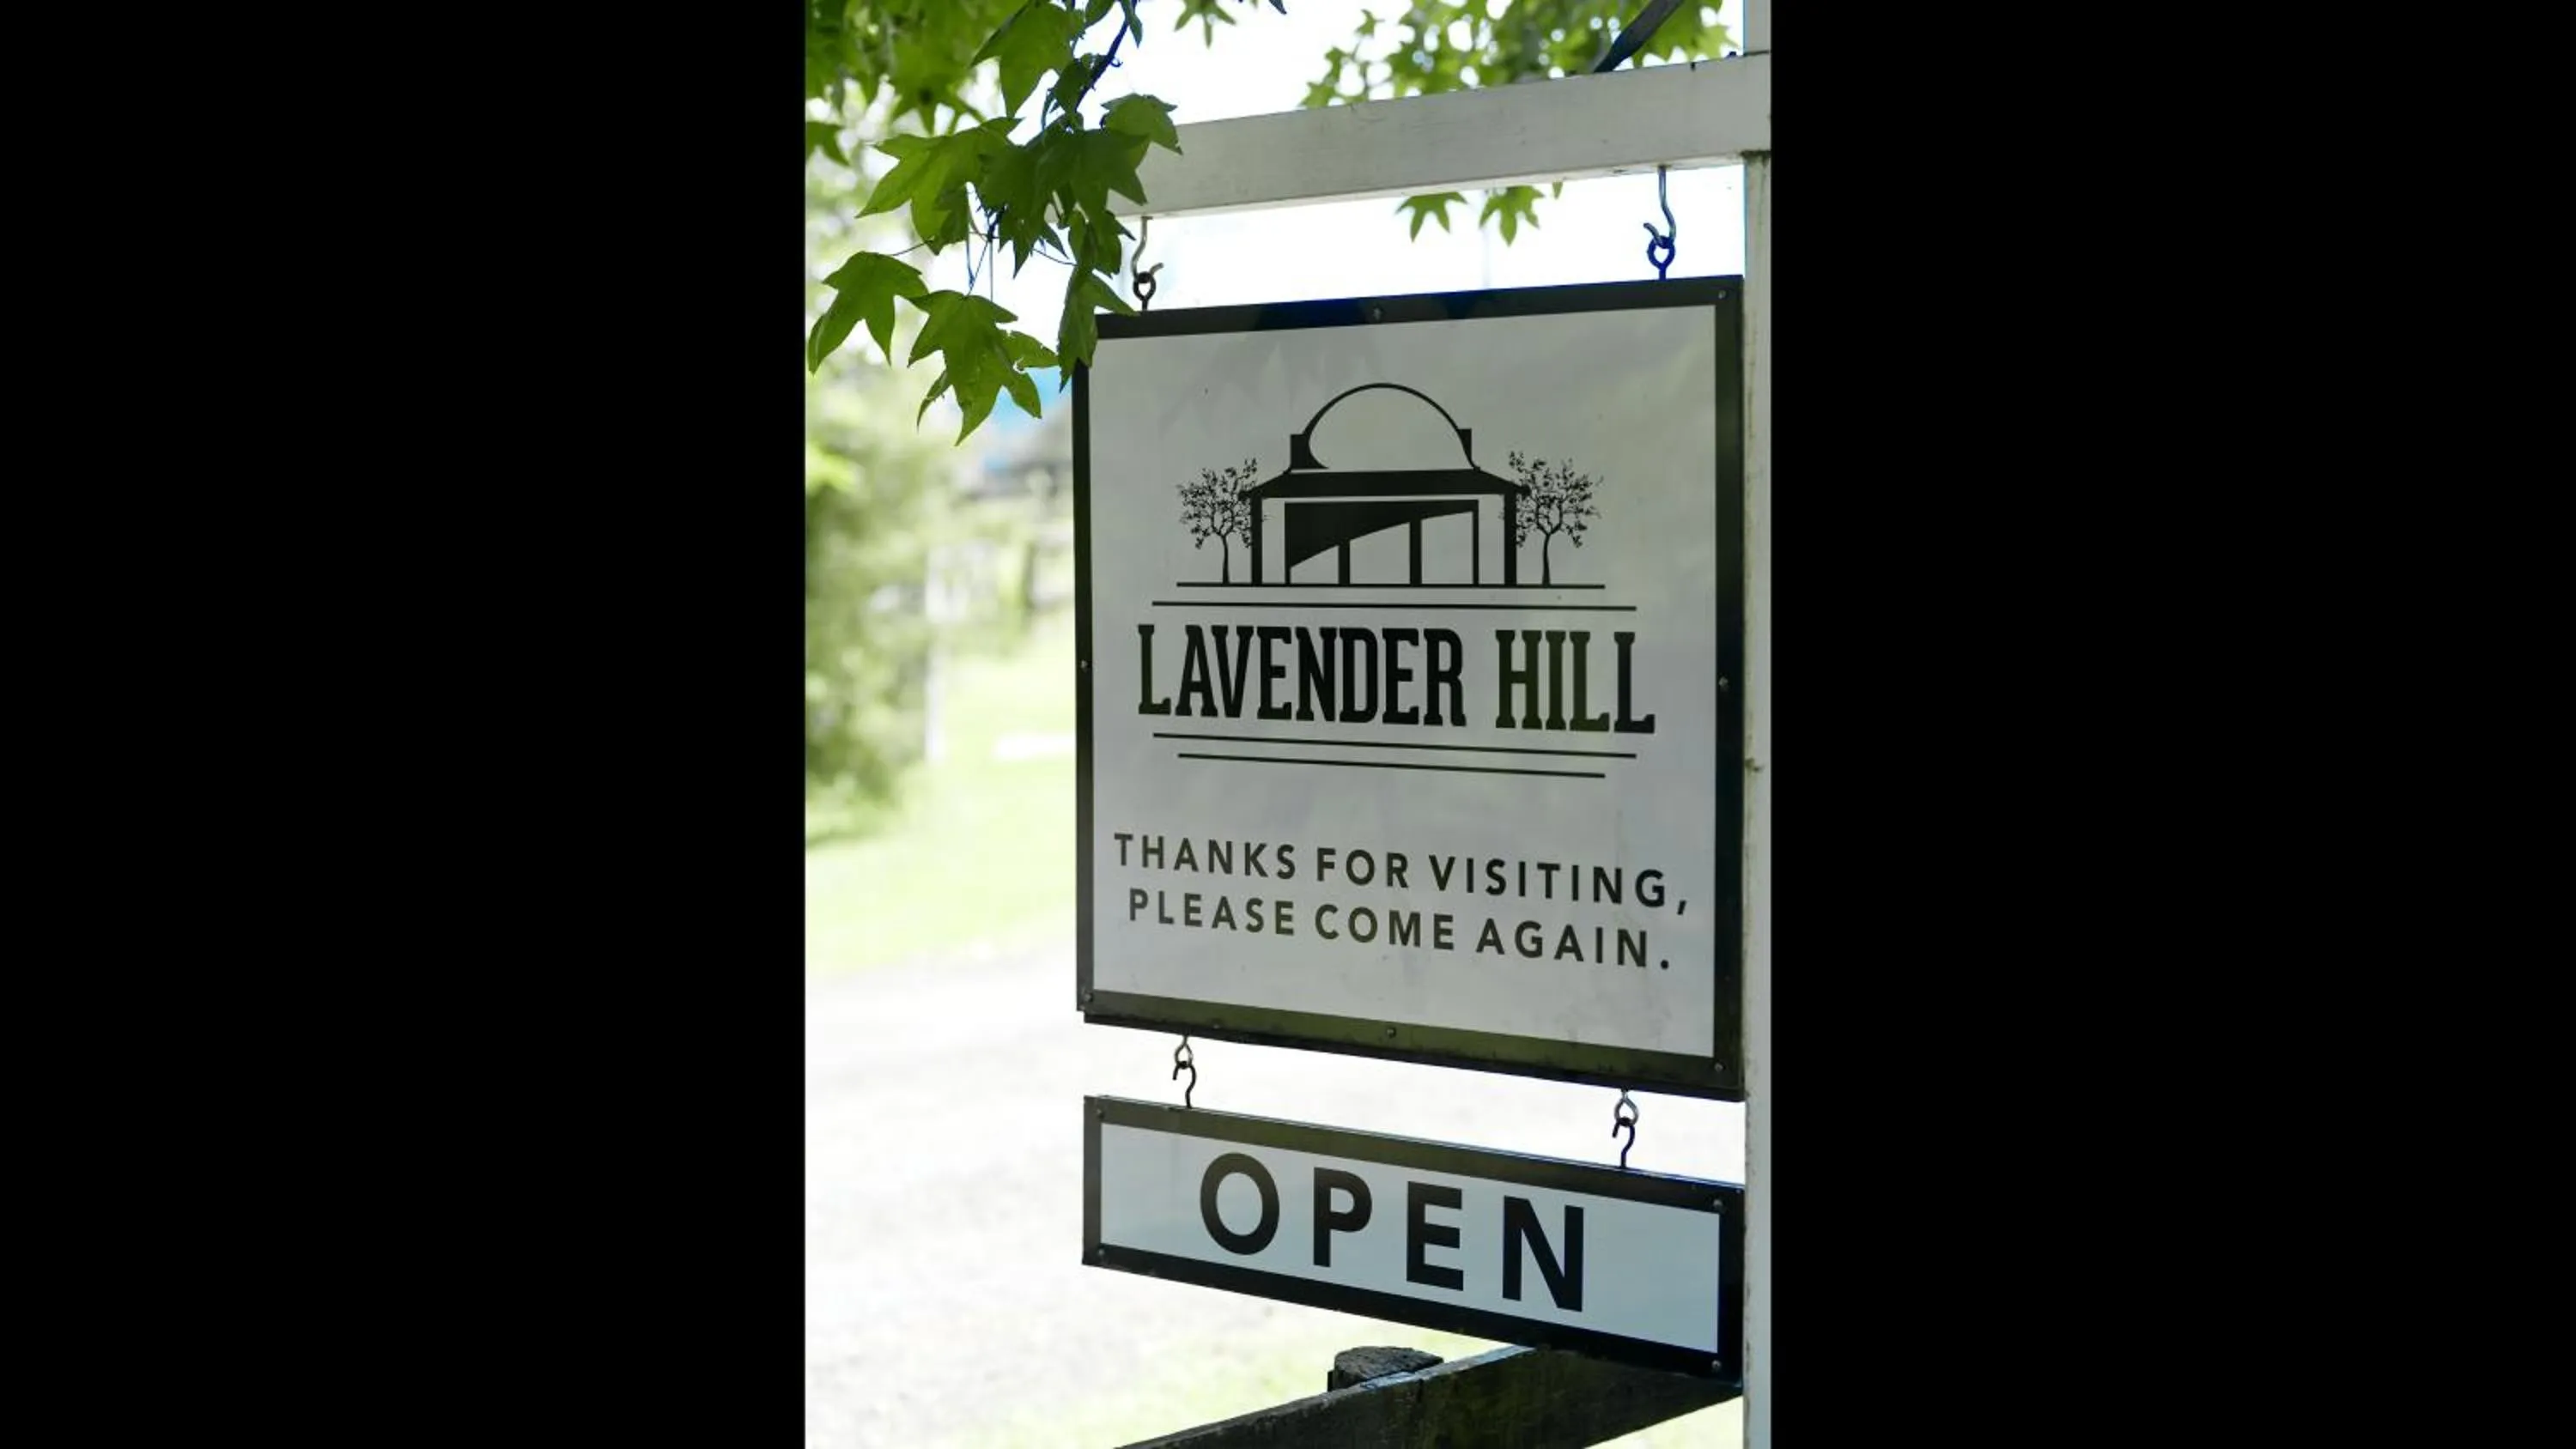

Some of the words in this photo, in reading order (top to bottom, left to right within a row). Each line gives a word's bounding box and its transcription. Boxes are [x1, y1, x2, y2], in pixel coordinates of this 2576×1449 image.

[1137, 623, 1467, 727] LAVENDER
[1494, 628, 1656, 735] HILL
[1114, 833, 1297, 880] THANKS
[1315, 846, 1409, 888] FOR
[1428, 854, 1688, 916] VISITING,
[1129, 888, 1295, 936] PLEASE
[1315, 904, 1455, 951] COME
[1475, 917, 1670, 970] AGAIN.
[1199, 1152, 1585, 1313] OPEN
